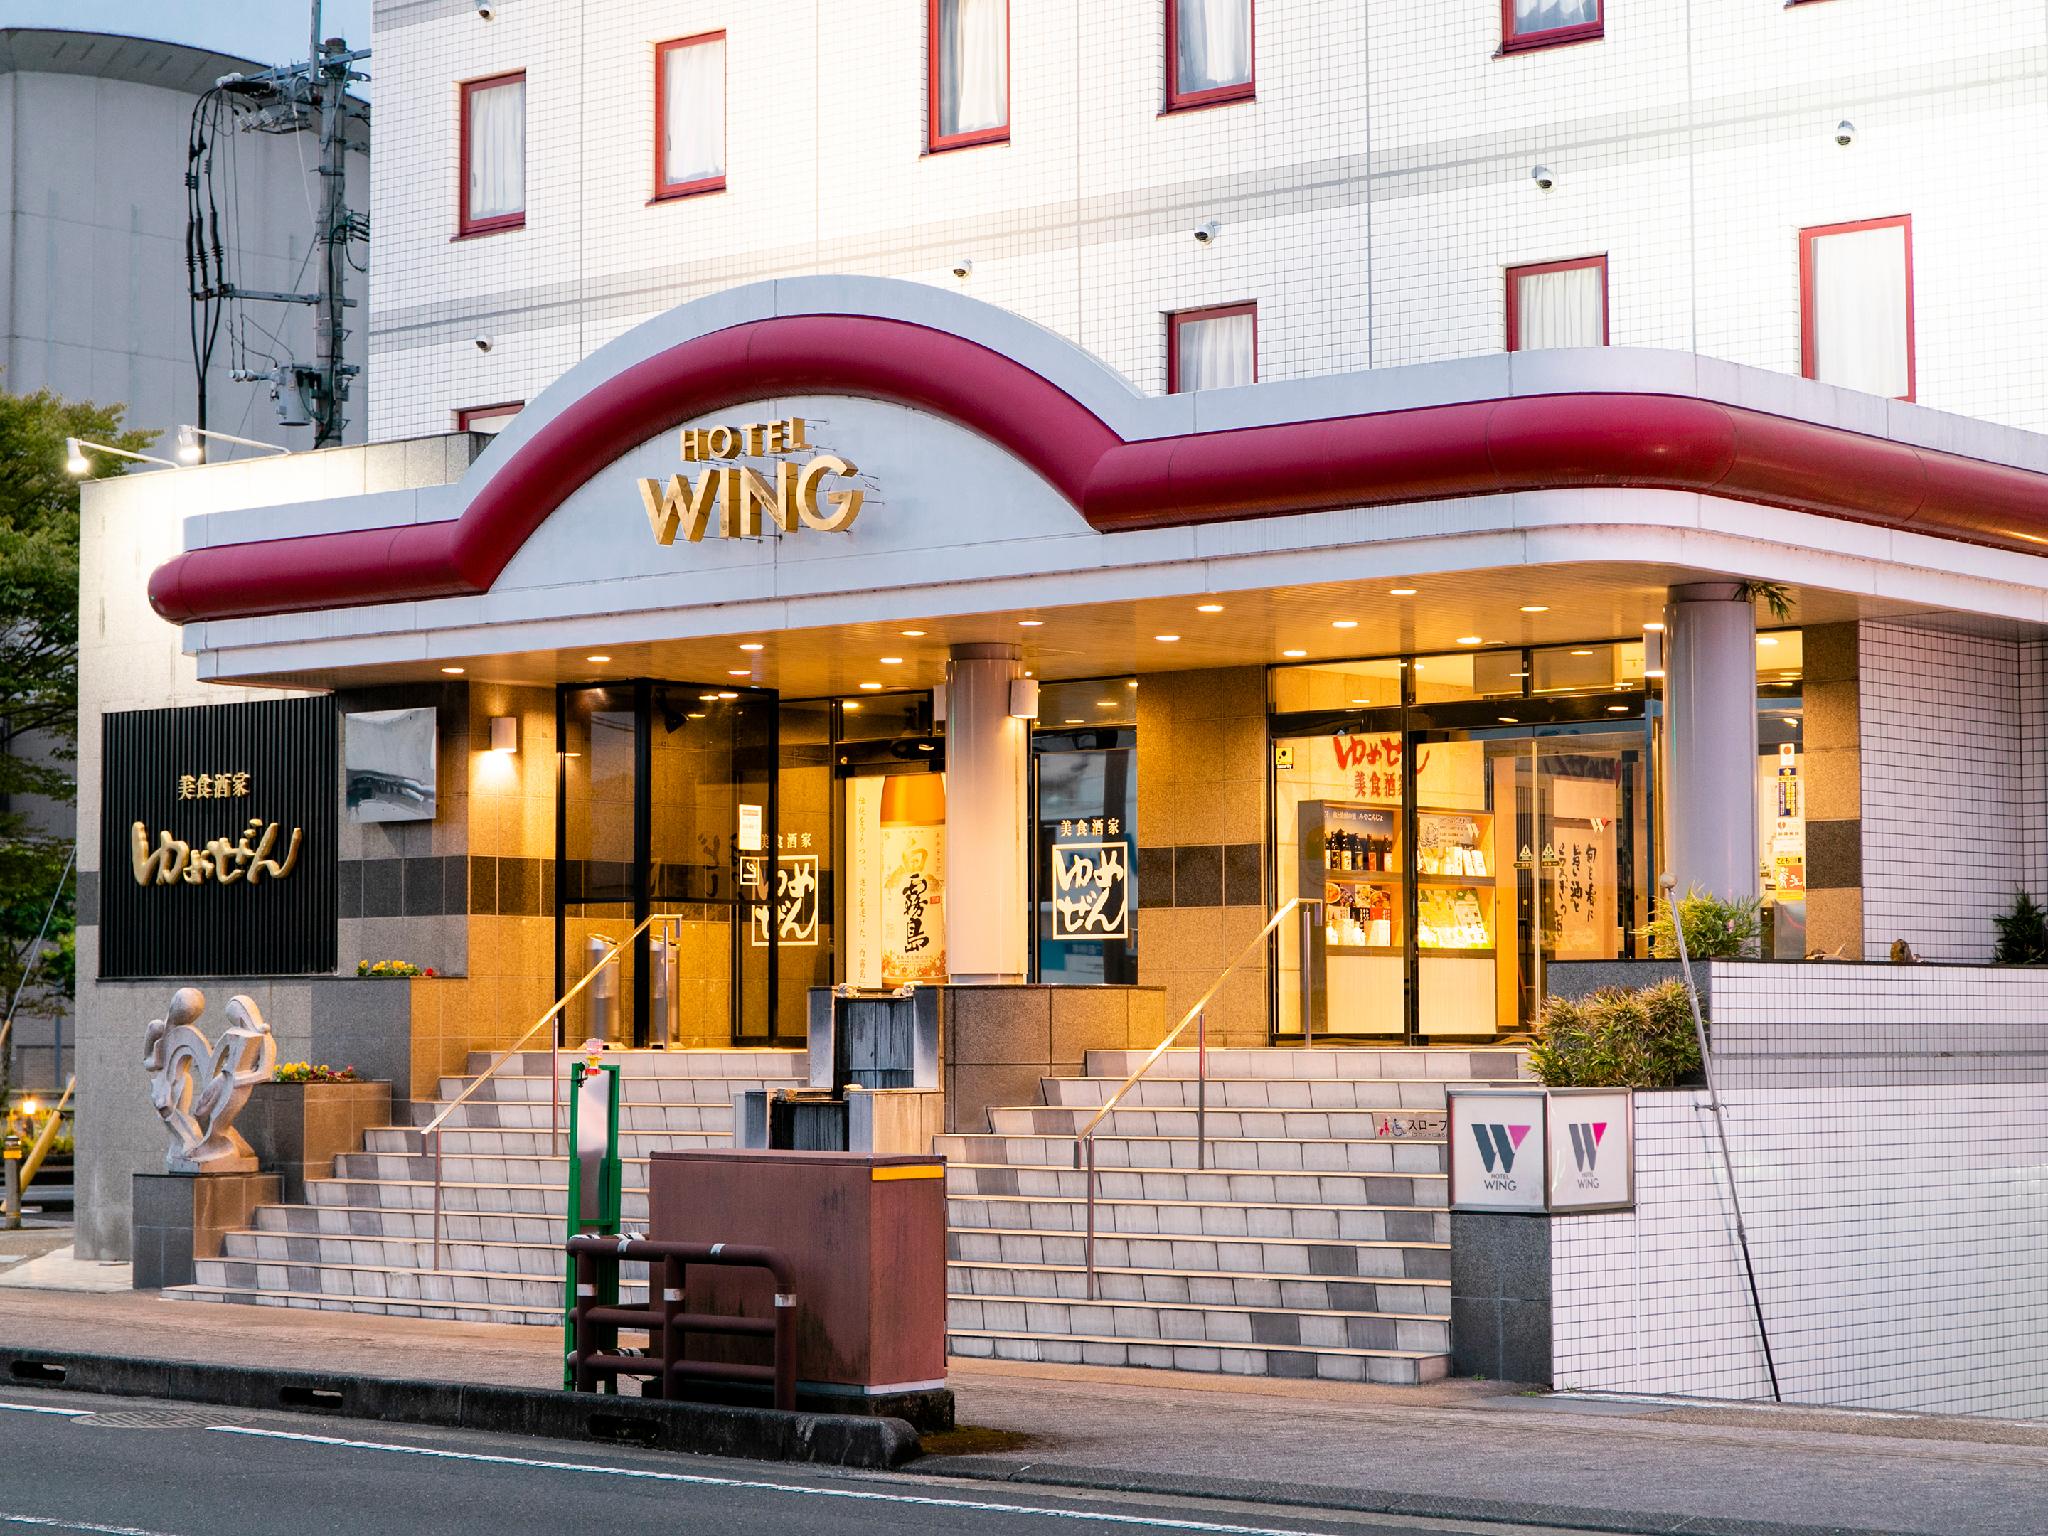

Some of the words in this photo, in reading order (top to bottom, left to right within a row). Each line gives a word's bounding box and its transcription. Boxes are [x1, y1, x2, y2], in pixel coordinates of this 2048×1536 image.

[680, 416, 813, 462] HOTEL
[637, 454, 864, 547] WING
[178, 771, 250, 800] 美食酒家
[1355, 770, 1402, 798] 美食酒
[1060, 817, 1120, 837] 美食酒家
[132, 818, 302, 886] ゆめぜん
[1056, 850, 1124, 891] ゆめ
[1057, 887, 1125, 932] ぜん
[1484, 1180, 1517, 1191] WING
[1577, 1178, 1600, 1189] WING
